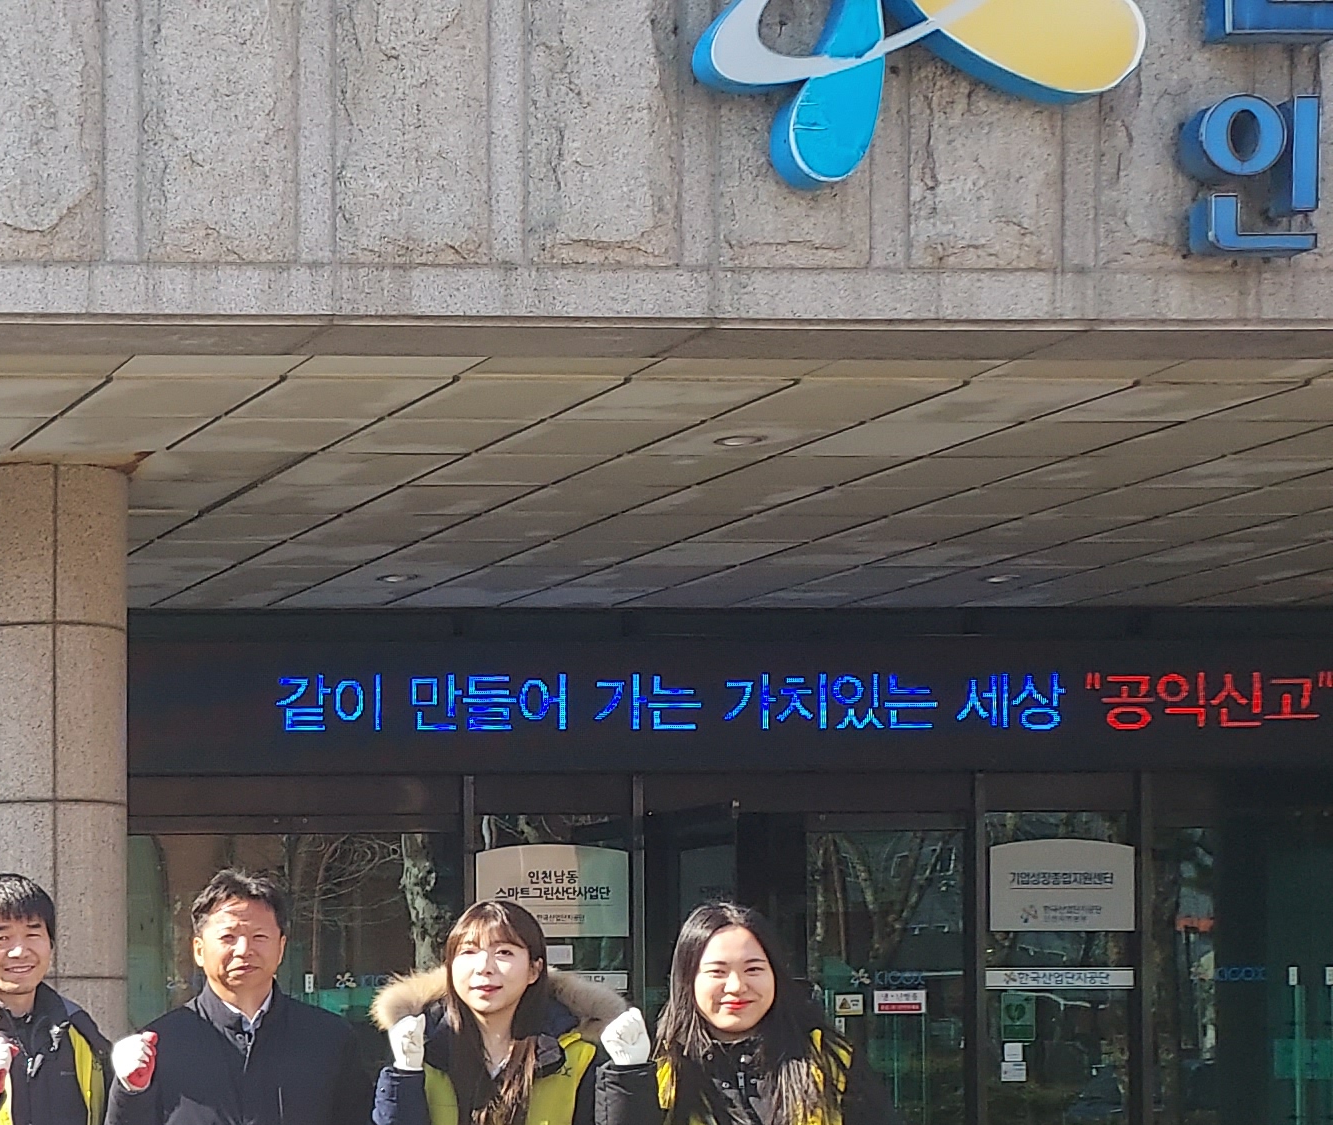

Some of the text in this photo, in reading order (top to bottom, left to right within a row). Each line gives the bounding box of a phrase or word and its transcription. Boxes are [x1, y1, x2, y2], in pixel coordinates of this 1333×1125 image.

[274, 671, 384, 731] 같이
[409, 671, 569, 731] 만들어
[592, 671, 703, 731] 가는
[723, 671, 939, 731] 가치있는
[956, 671, 1067, 731] 세상
[528, 870, 579, 884] 인천남동
[495, 886, 611, 901] 스마트그린산단사업단
[1017, 971, 1110, 985] 한국산업단지공단
